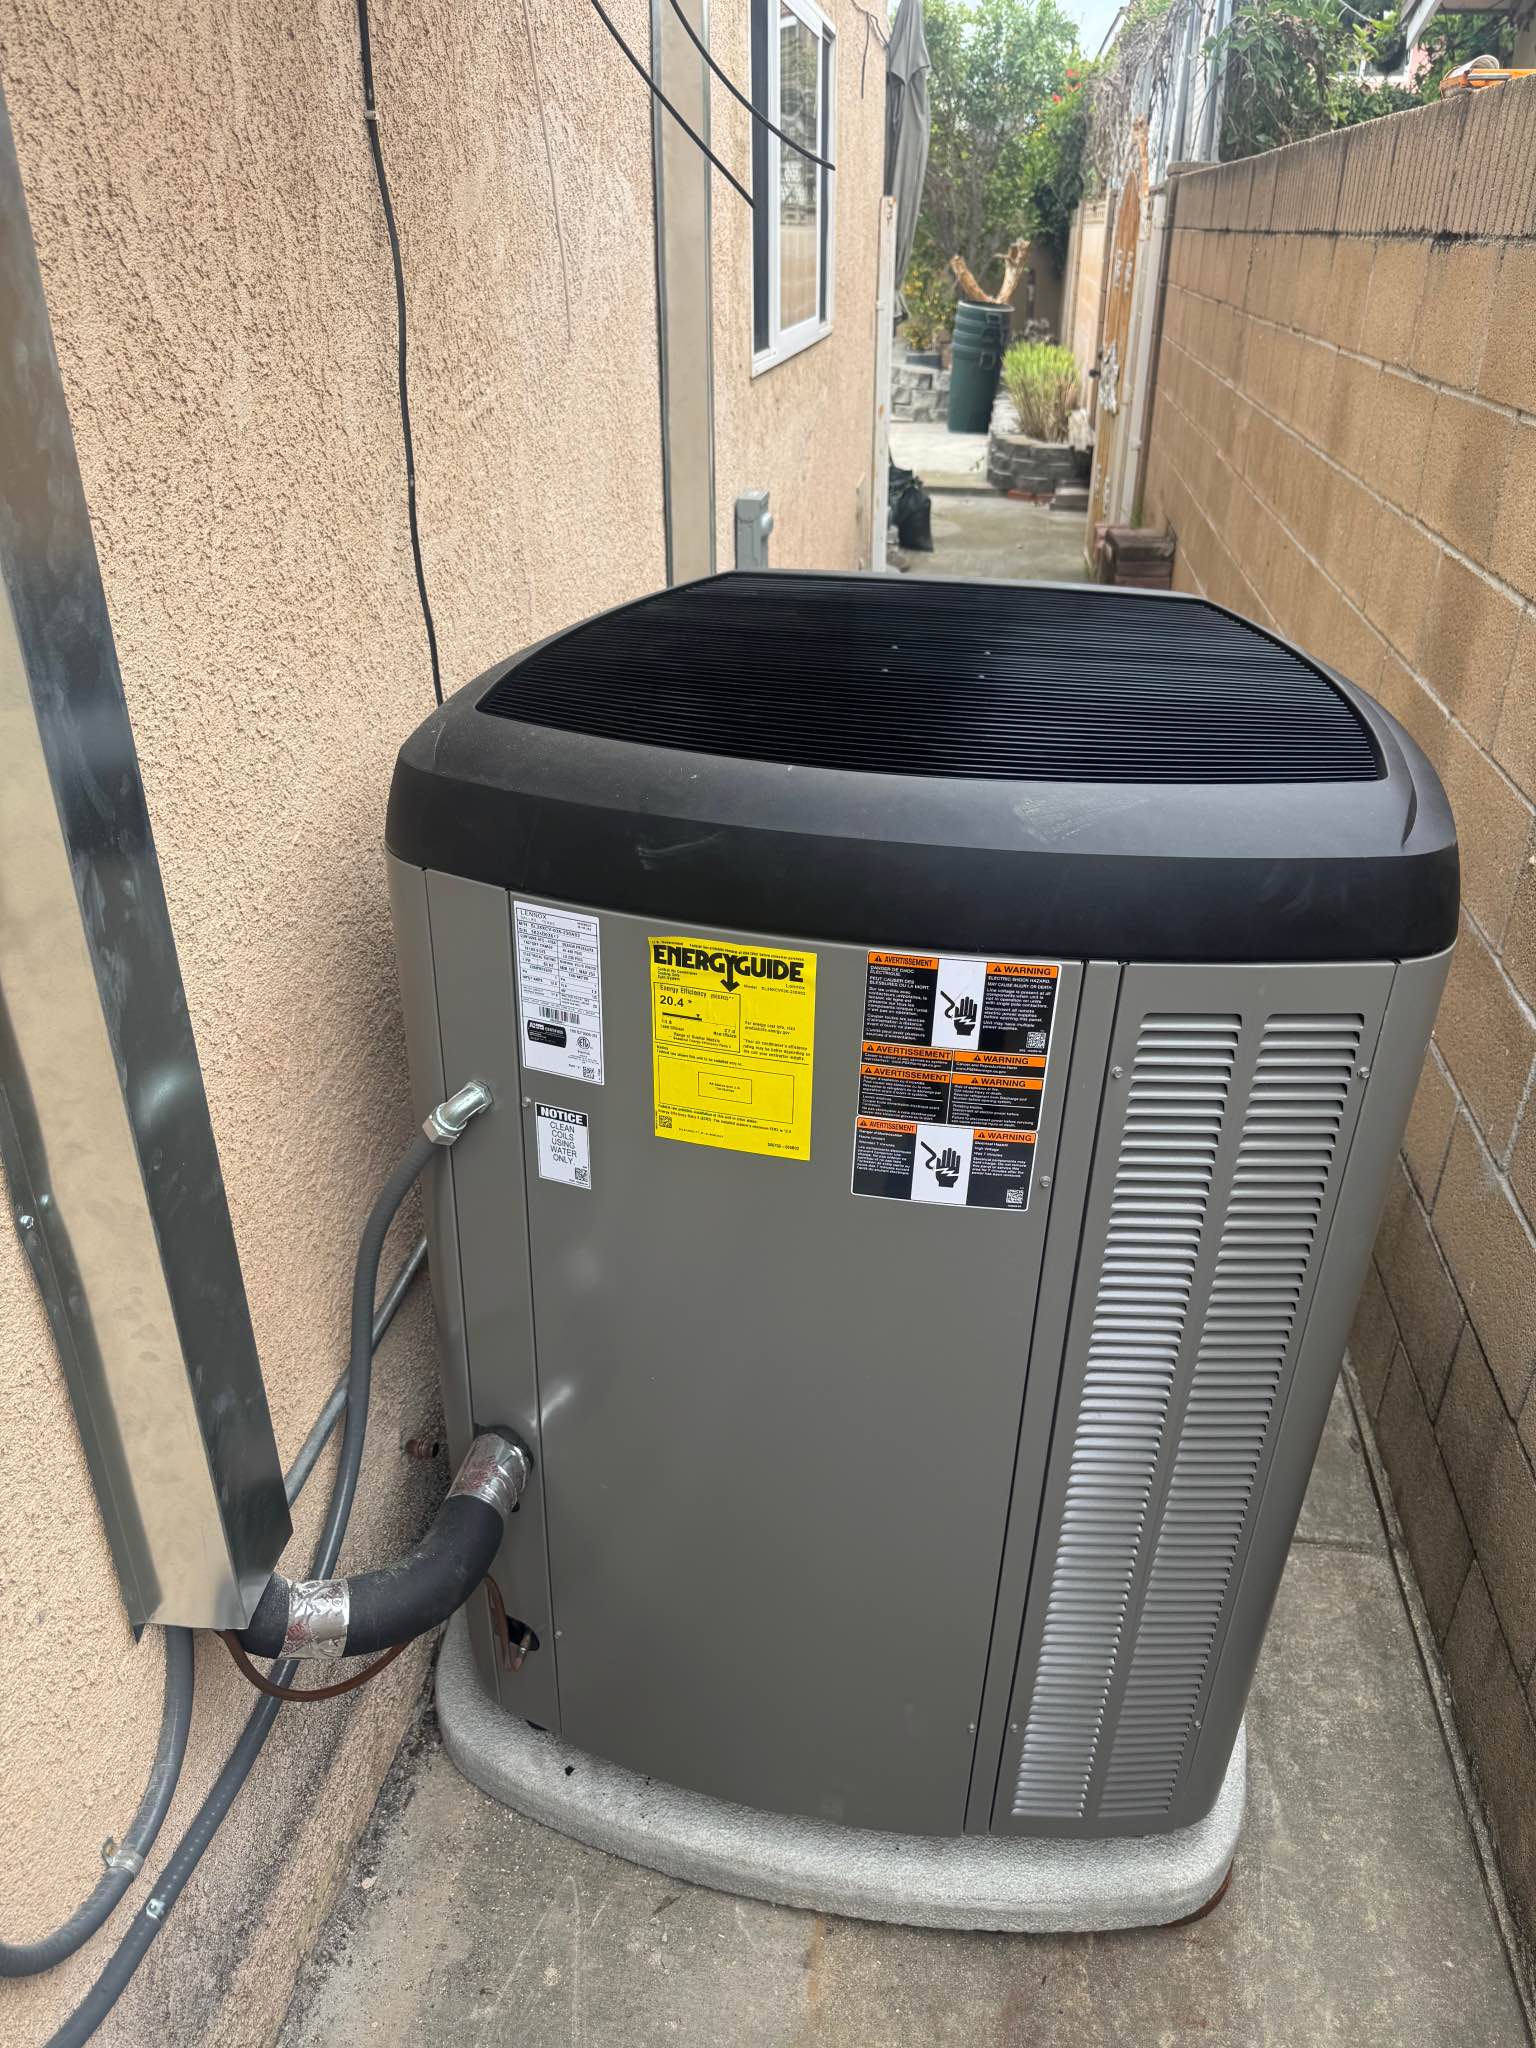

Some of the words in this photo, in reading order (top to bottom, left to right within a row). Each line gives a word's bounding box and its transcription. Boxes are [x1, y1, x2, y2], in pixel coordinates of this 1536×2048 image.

[520, 909, 546, 919] LENNOX
[654, 945, 804, 983] ENERGYGUIDE
[885, 956, 932, 967] AVERTISSEMENT
[1004, 966, 1051, 976] WARNING
[661, 985, 678, 994] Energy
[660, 995, 684, 1007] 20.4
[876, 1045, 951, 1059] AVERTISSEMENT
[983, 1055, 1028, 1065] WARNING
[874, 1068, 948, 1082] AVERTISSEMENT
[981, 1078, 1026, 1088] WARNING
[540, 1106, 583, 1124] NOTICE
[550, 1121, 575, 1133] CLEAN
[869, 1121, 914, 1132] AVERTISSEMENT
[551, 1129, 574, 1141] COILS
[987, 1132, 1032, 1142] WARNING
[552, 1138, 575, 1149] USING
[550, 1146, 577, 1158] WATER
